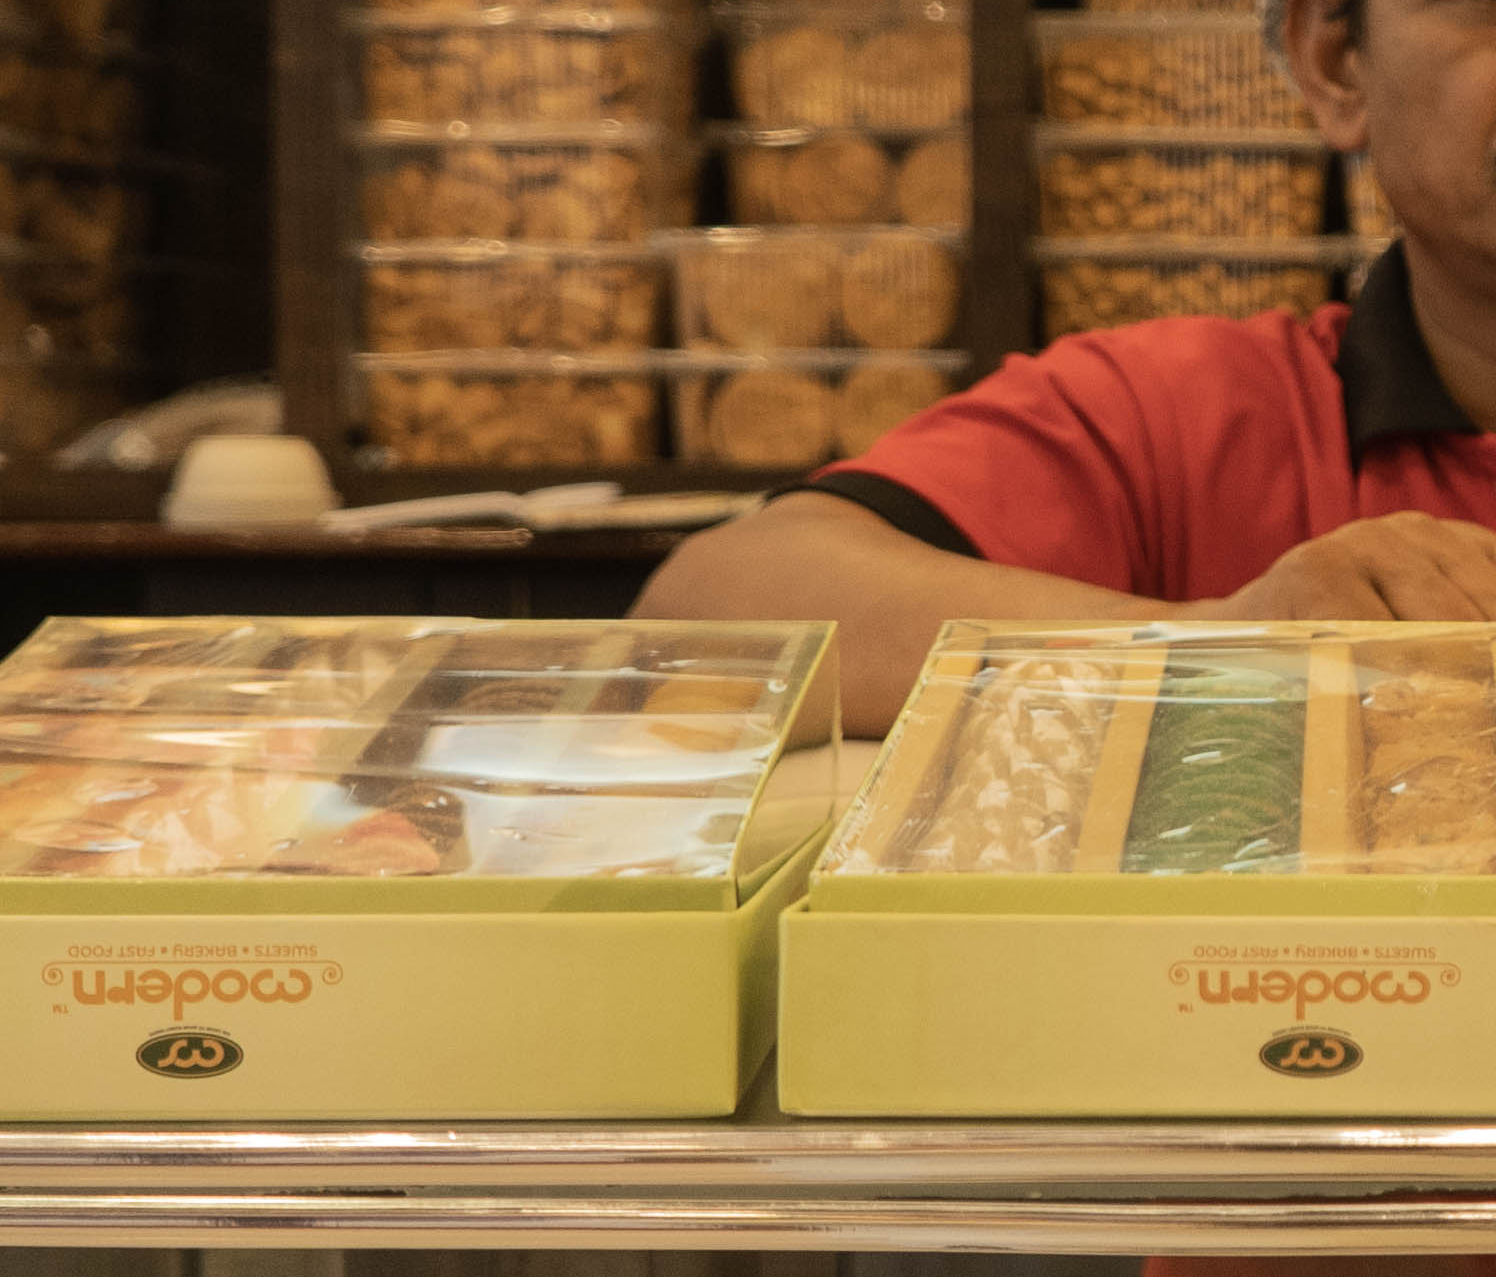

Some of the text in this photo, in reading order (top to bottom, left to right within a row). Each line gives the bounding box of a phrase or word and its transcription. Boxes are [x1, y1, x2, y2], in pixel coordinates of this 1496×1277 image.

[68, 945, 317, 957] SWEETS BAKERY FAST FOOD
[1194, 945, 1436, 958] SWEETS BAKERY FAST FOOD
[73, 969, 312, 1021] modern
[1198, 971, 1430, 1021] modern
